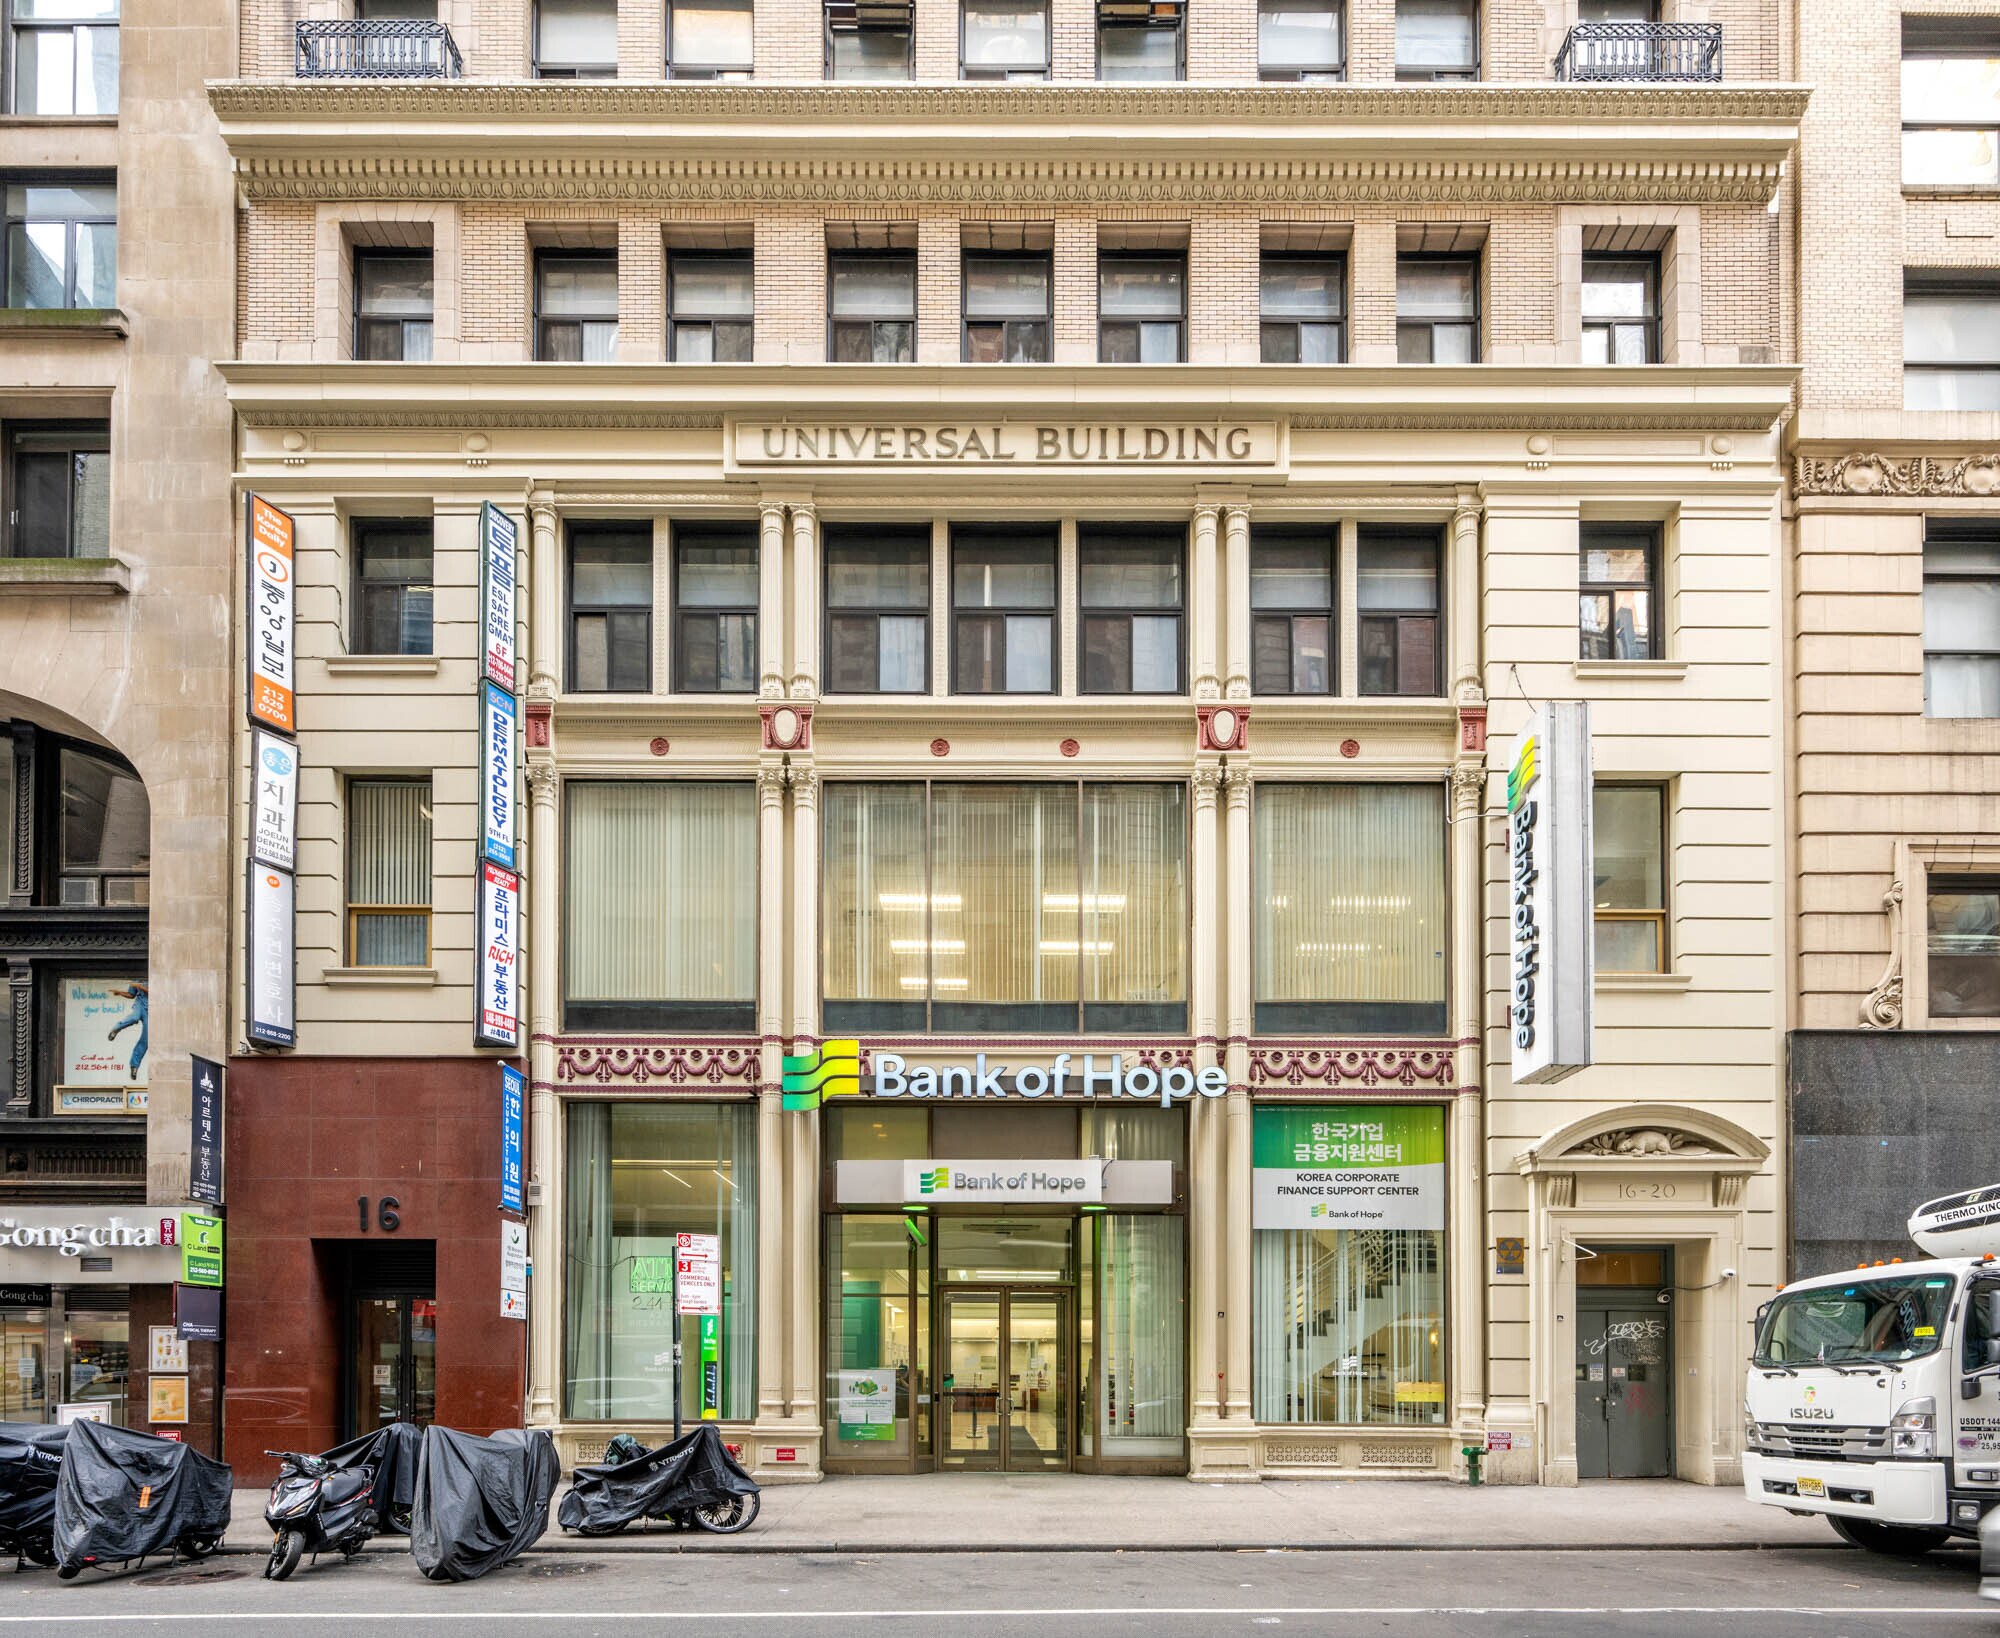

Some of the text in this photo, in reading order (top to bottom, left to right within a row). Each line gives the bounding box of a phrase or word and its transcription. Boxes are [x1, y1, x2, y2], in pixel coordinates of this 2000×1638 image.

[762, 428, 1253, 459] UNIVERSAL BUILDING
[264, 508, 282, 526] The
[256, 513, 289, 541] Korea
[258, 524, 286, 549] Daily
[491, 586, 508, 605] ESL
[491, 600, 508, 618] SAT
[490, 612, 509, 632] GRE
[488, 623, 514, 647] GMAT
[495, 642, 508, 658] 6F
[261, 695, 284, 711] 629
[263, 685, 285, 703] 212
[258, 703, 287, 722] 0700
[492, 711, 508, 829] DERMATOLOGY
[263, 780, 286, 832] 치과
[256, 835, 291, 854] DENTAL
[259, 827, 289, 844] JOEUN
[494, 887, 509, 948] 프라미스
[1512, 801, 1539, 1049] Bank of Hope
[487, 945, 515, 967] RICH
[72, 986, 108, 1000] We have
[493, 963, 509, 1012] 부동산
[84, 1005, 100, 1018] your
[875, 1053, 1228, 1108] Bank of Hope
[201, 1096, 211, 1142] 아르테스
[510, 1096, 520, 1184] 한의원
[1311, 1122, 1383, 1141] 한국기업
[1293, 1143, 1402, 1162] 금융지원센터
[200, 1145, 210, 1181] 부동산
[954, 1172, 1086, 1194] Bank of Hope
[1296, 1173, 1400, 1182] KOREA CORPORATE
[1277, 1186, 1419, 1196] FINANCE SUPPORT CENTER
[1618, 1183, 1676, 1198] 16-20
[358, 1196, 400, 1232] 16
[1328, 1210, 1383, 1220] Bank of Hope
[1935, 1207, 1977, 1223] THERMO
[90, 1217, 155, 1246] cha
[162, 1220, 174, 1245] 貢茶
[681, 1262, 689, 1272] 3
[0, 1289, 27, 1303] Gong
[27, 1290, 44, 1302] cha
[1901, 1380, 1906, 1390] 5
[1790, 1407, 1834, 1420] ISUZU
[1960, 1417, 1985, 1425] USDOT
[1977, 1433, 1995, 1441] GVW
